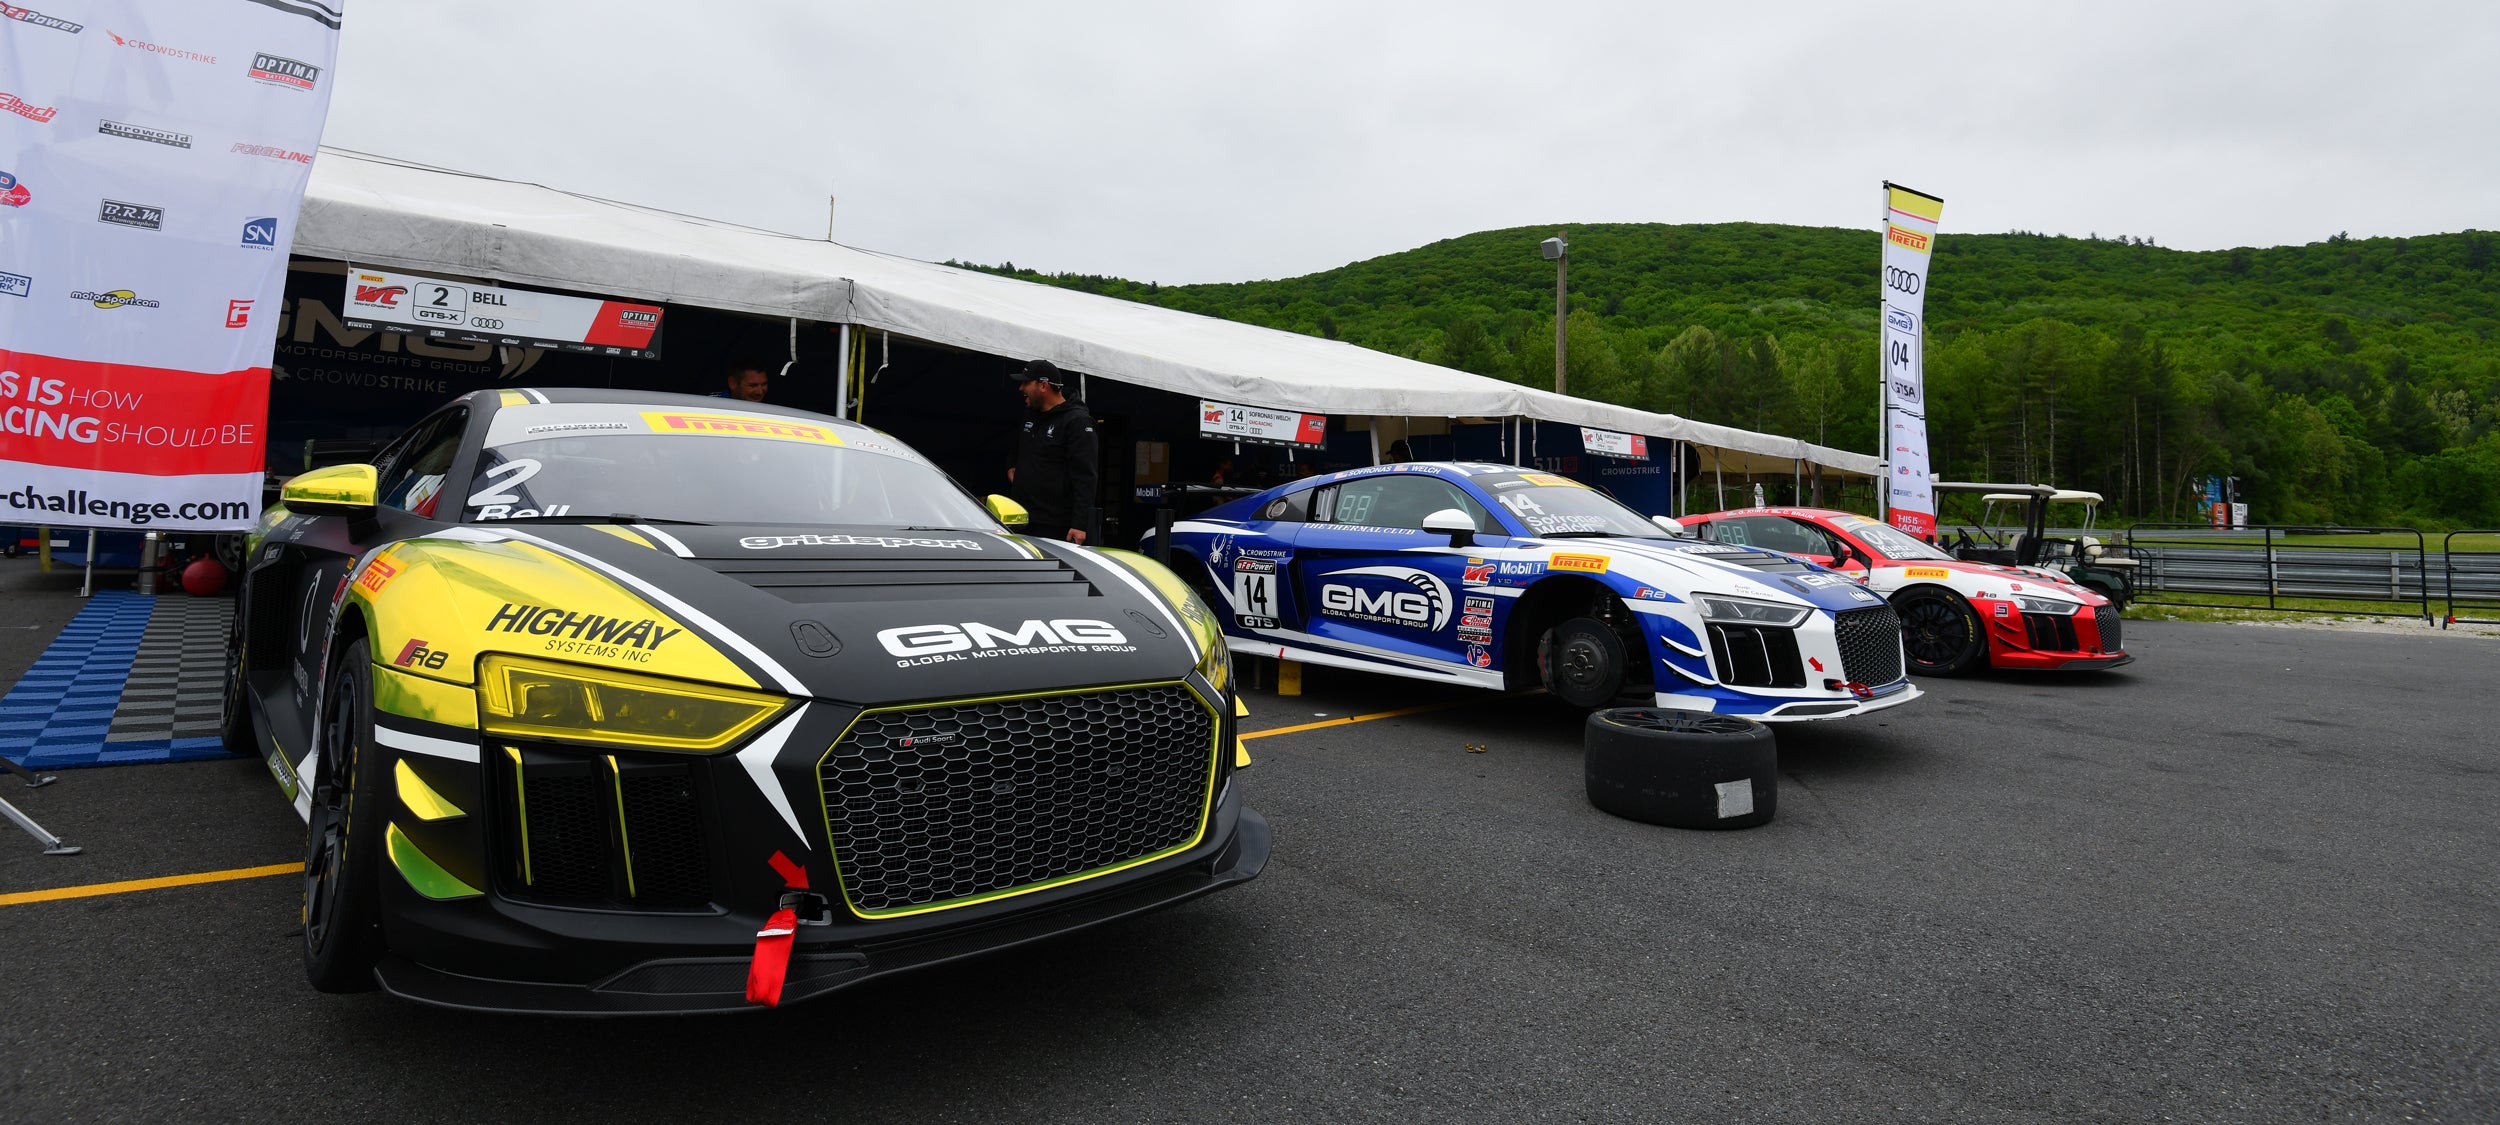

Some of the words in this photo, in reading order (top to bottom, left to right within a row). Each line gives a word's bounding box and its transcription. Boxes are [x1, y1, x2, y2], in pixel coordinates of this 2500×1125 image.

[128, 39, 217, 65] CROWDSTRIKE
[256, 56, 316, 81] OPTIMA
[265, 73, 301, 85] BATTERIES
[231, 143, 313, 164] FORGELINE
[103, 203, 161, 222] B.R.M
[246, 225, 273, 243] SN
[1888, 226, 1928, 250] PIRELLI
[361, 275, 383, 283] PIRELLI
[71, 290, 159, 309] motorsport.com
[355, 285, 407, 305] WC
[433, 287, 448, 306] 2
[472, 291, 507, 306] BELL
[419, 310, 458, 321] GTS-X
[622, 311, 657, 322] OPTIMA
[1888, 315, 1908, 329] GMG
[348, 321, 372, 329] PIRELLI
[1892, 340, 1909, 371] 04
[431, 360, 491, 375] GROUP
[297, 367, 447, 393] CROWDSTRIKE
[27, 376, 66, 405] IS
[69, 387, 143, 410] HOW
[1204, 410, 1224, 422] WC
[1231, 409, 1244, 422] 14
[0, 405, 101, 443] CING
[104, 422, 216, 447] SHOULD
[221, 424, 254, 444] BE
[663, 416, 825, 440] PIRELLI
[1347, 466, 1392, 477] SOFRONAS
[1411, 466, 1441, 474] WELCH
[1534, 457, 1562, 472] 5.11
[1602, 467, 1660, 475] CROWDSTRIKE
[468, 458, 542, 506] 2
[1136, 488, 1153, 497] Mobil
[0, 485, 249, 524] -challenge.com
[1498, 494, 1545, 517] 14
[1527, 513, 1607, 527] Sofronas
[1791, 511, 1815, 519] BRAUN
[1303, 522, 1327, 530] THE
[1328, 523, 1382, 534] THERMAL
[1383, 526, 1416, 536] CLUB
[740, 534, 983, 551] gridsport
[1860, 530, 1894, 545] 04
[1246, 549, 1286, 557] CROWDSTRIKE
[1878, 544, 1912, 553] Kurtz
[1886, 551, 1921, 560] Braun
[1237, 561, 1273, 571] aFePower
[1500, 563, 1532, 575] Mobil
[1552, 556, 1604, 569] PIRELLI
[1464, 564, 1496, 582] WC
[1244, 575, 1267, 616] 14
[1641, 588, 1666, 599] R8
[1322, 583, 1429, 621] GMG
[1467, 600, 1491, 609] OPTIMA
[1244, 616, 1273, 628] GTS
[1322, 608, 1346, 617] GLOBAL
[1349, 612, 1400, 625] MOTORSPORTS
[1403, 620, 1428, 628] GROUP
[1461, 616, 1491, 627] Eibach
[485, 603, 682, 650] HIGHWAY
[1964, 614, 1974, 642] PIRELLI
[877, 619, 1127, 657] GMG
[1458, 634, 1491, 642] FORGELINE
[408, 645, 449, 670] R8
[545, 640, 618, 658] SYSTEMS
[622, 649, 652, 663] INC
[897, 654, 967, 668] GLOBAL
[972, 645, 1087, 659] MOTORSPORTS
[1468, 645, 1484, 666] VP
[914, 736, 931, 744] Audi
[932, 734, 953, 743] Sport
